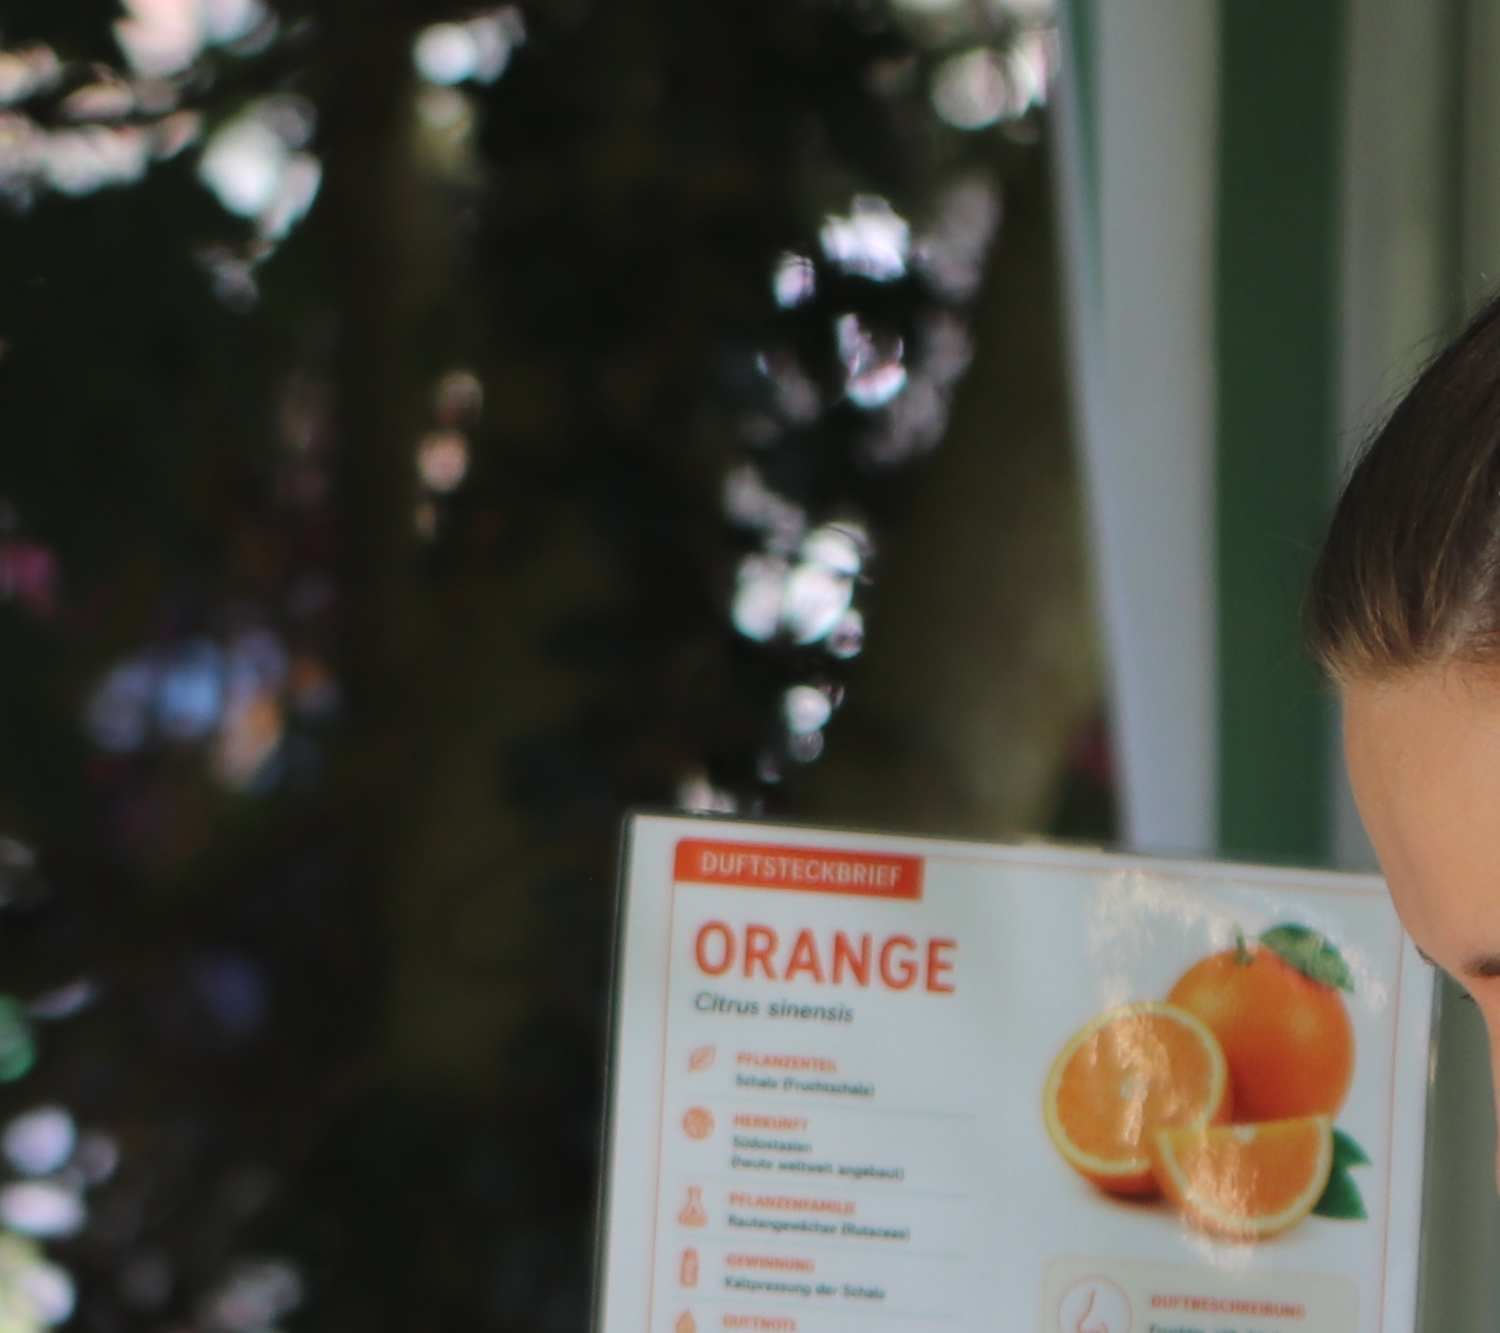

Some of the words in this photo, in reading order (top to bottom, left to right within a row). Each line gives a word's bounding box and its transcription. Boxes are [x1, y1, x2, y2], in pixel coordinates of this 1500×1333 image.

[700, 851, 903, 888] DUFTSTECKBRIEF
[692, 920, 957, 995] ORANGE
[691, 989, 760, 1016] Citrus
[766, 997, 854, 1023] sinensis
